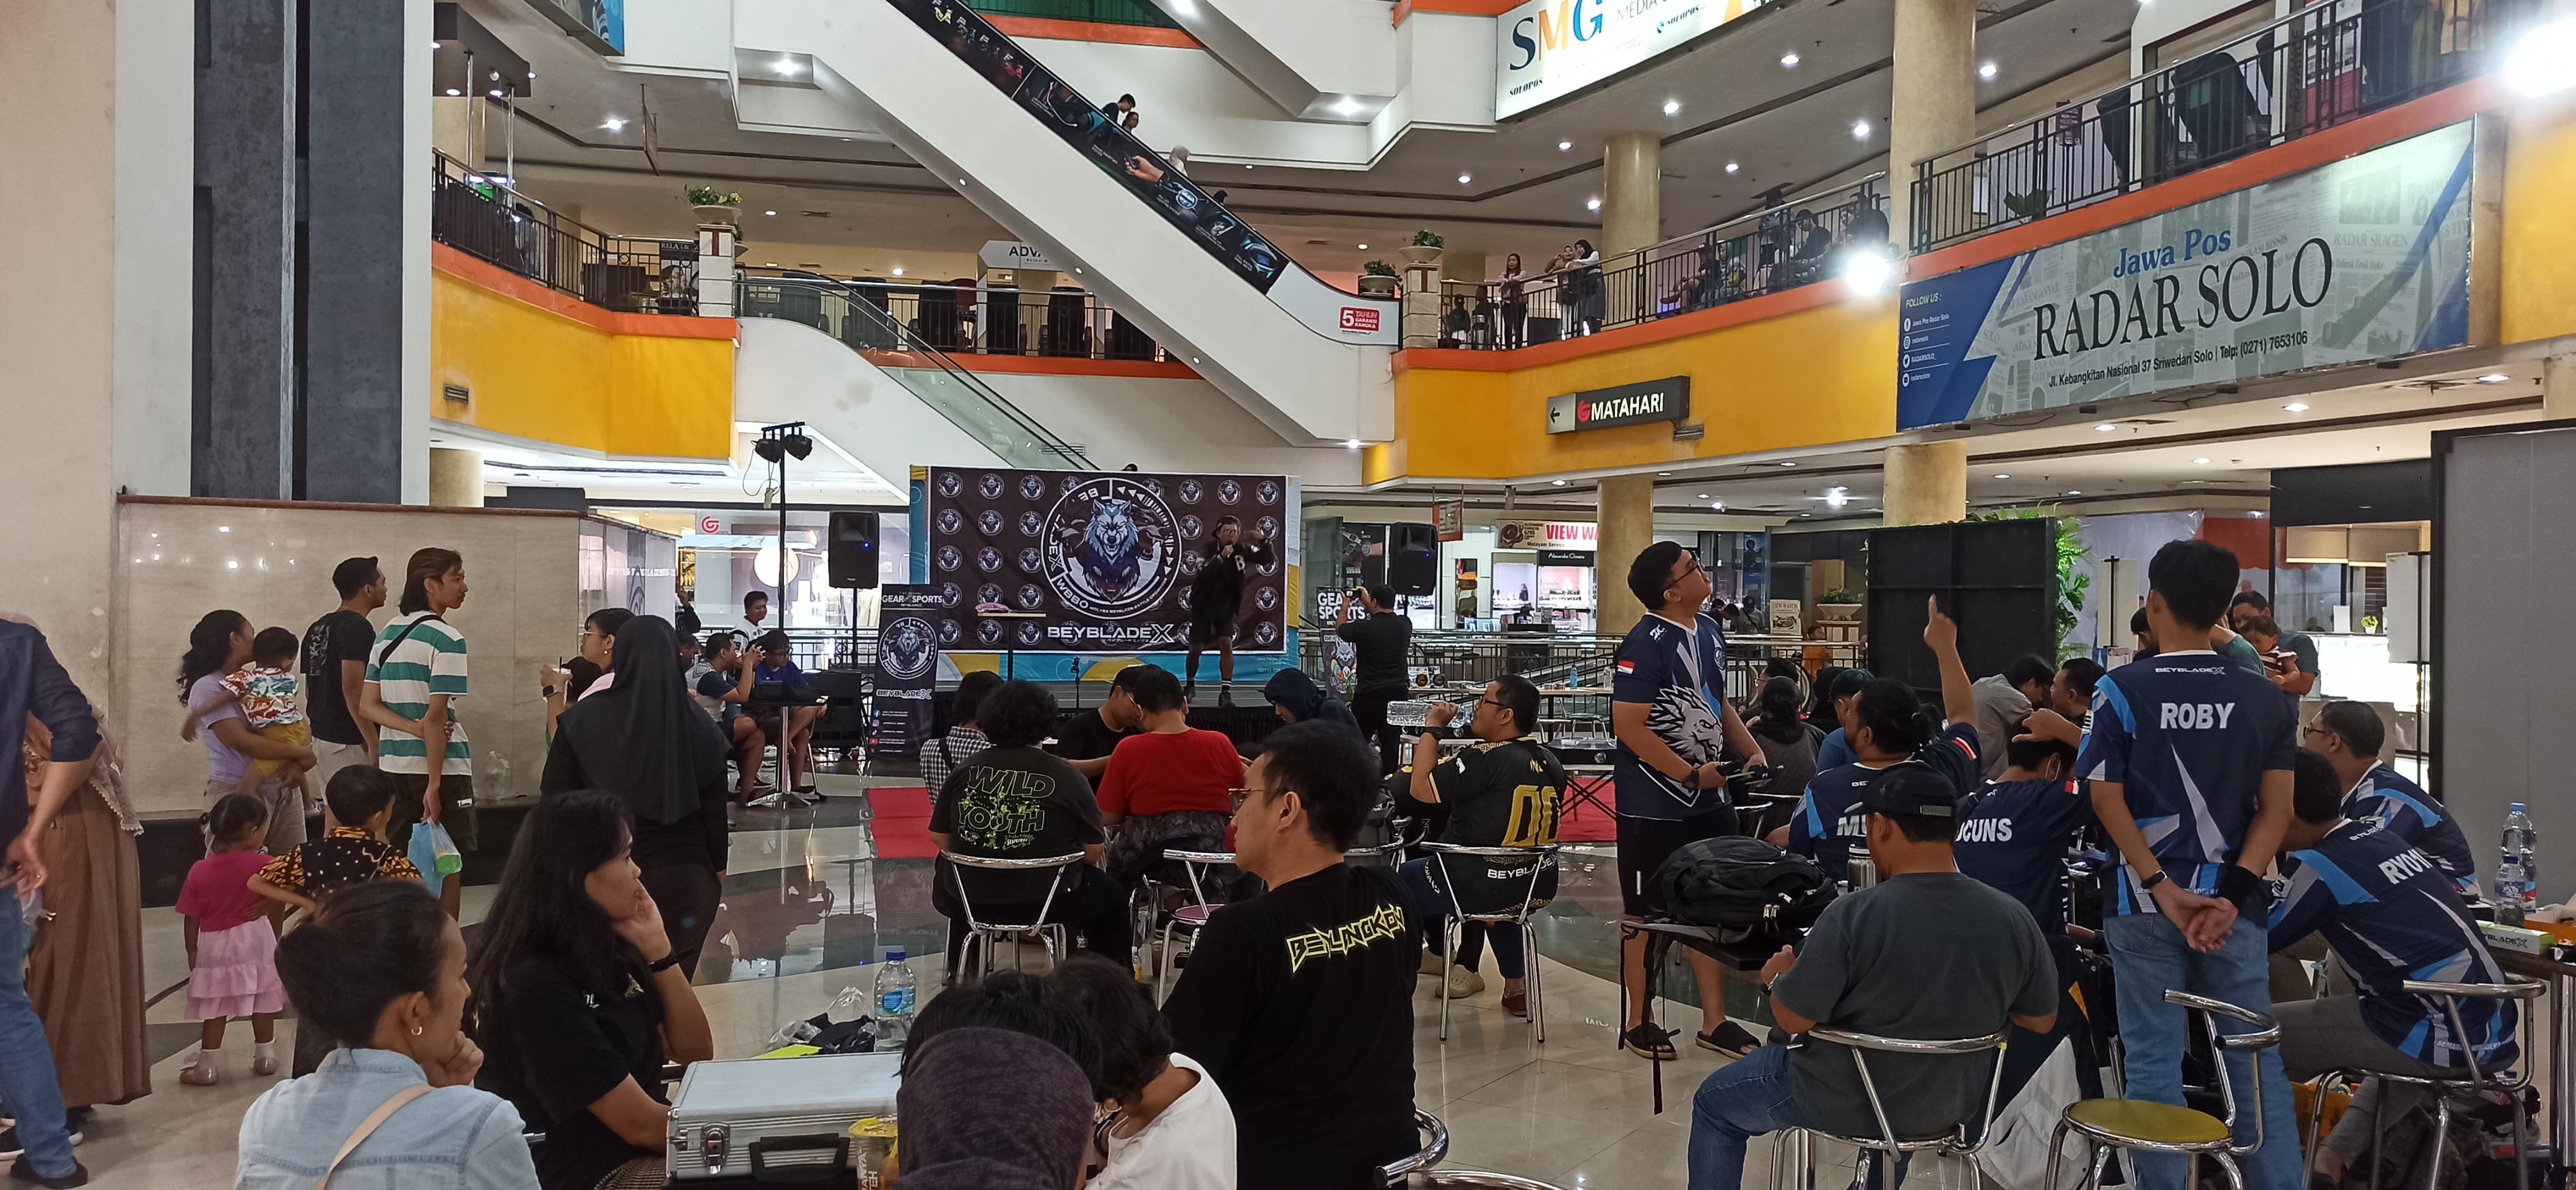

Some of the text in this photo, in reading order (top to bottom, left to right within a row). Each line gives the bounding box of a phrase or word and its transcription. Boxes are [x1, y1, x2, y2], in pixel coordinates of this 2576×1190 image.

[1510, 0, 1603, 71] SMG
[1509, 78, 1543, 97] SOLOPOS
[2113, 228, 2232, 278] Jawa Pos
[1905, 294, 1930, 308] FOLLOW
[1930, 292, 1939, 303] US
[2033, 237, 2333, 361] RADAR SOLO
[1342, 310, 1354, 326] 5
[2049, 374, 2058, 388] Jl.
[2059, 367, 2106, 386] Kebangkitan
[2106, 361, 2141, 380] Nasional
[2141, 359, 2152, 373] 37
[2153, 352, 2193, 370] Sriwedari
[2193, 350, 2214, 365] Solo
[2219, 344, 2239, 360] Telp:
[2240, 336, 2268, 358] (0271)
[2269, 330, 2308, 352] 7653106
[1591, 392, 1664, 421] MATAHARI
[1546, 525, 1578, 540] VIEW
[882, 595, 943, 603] GEAR SPORTS
[1317, 592, 1342, 606] GEA
[2160, 702, 2235, 729] ROBY
[967, 765, 1056, 798] WILD
[958, 801, 1045, 834] YOUTH
[2482, 934, 2528, 948] YBLADEX
